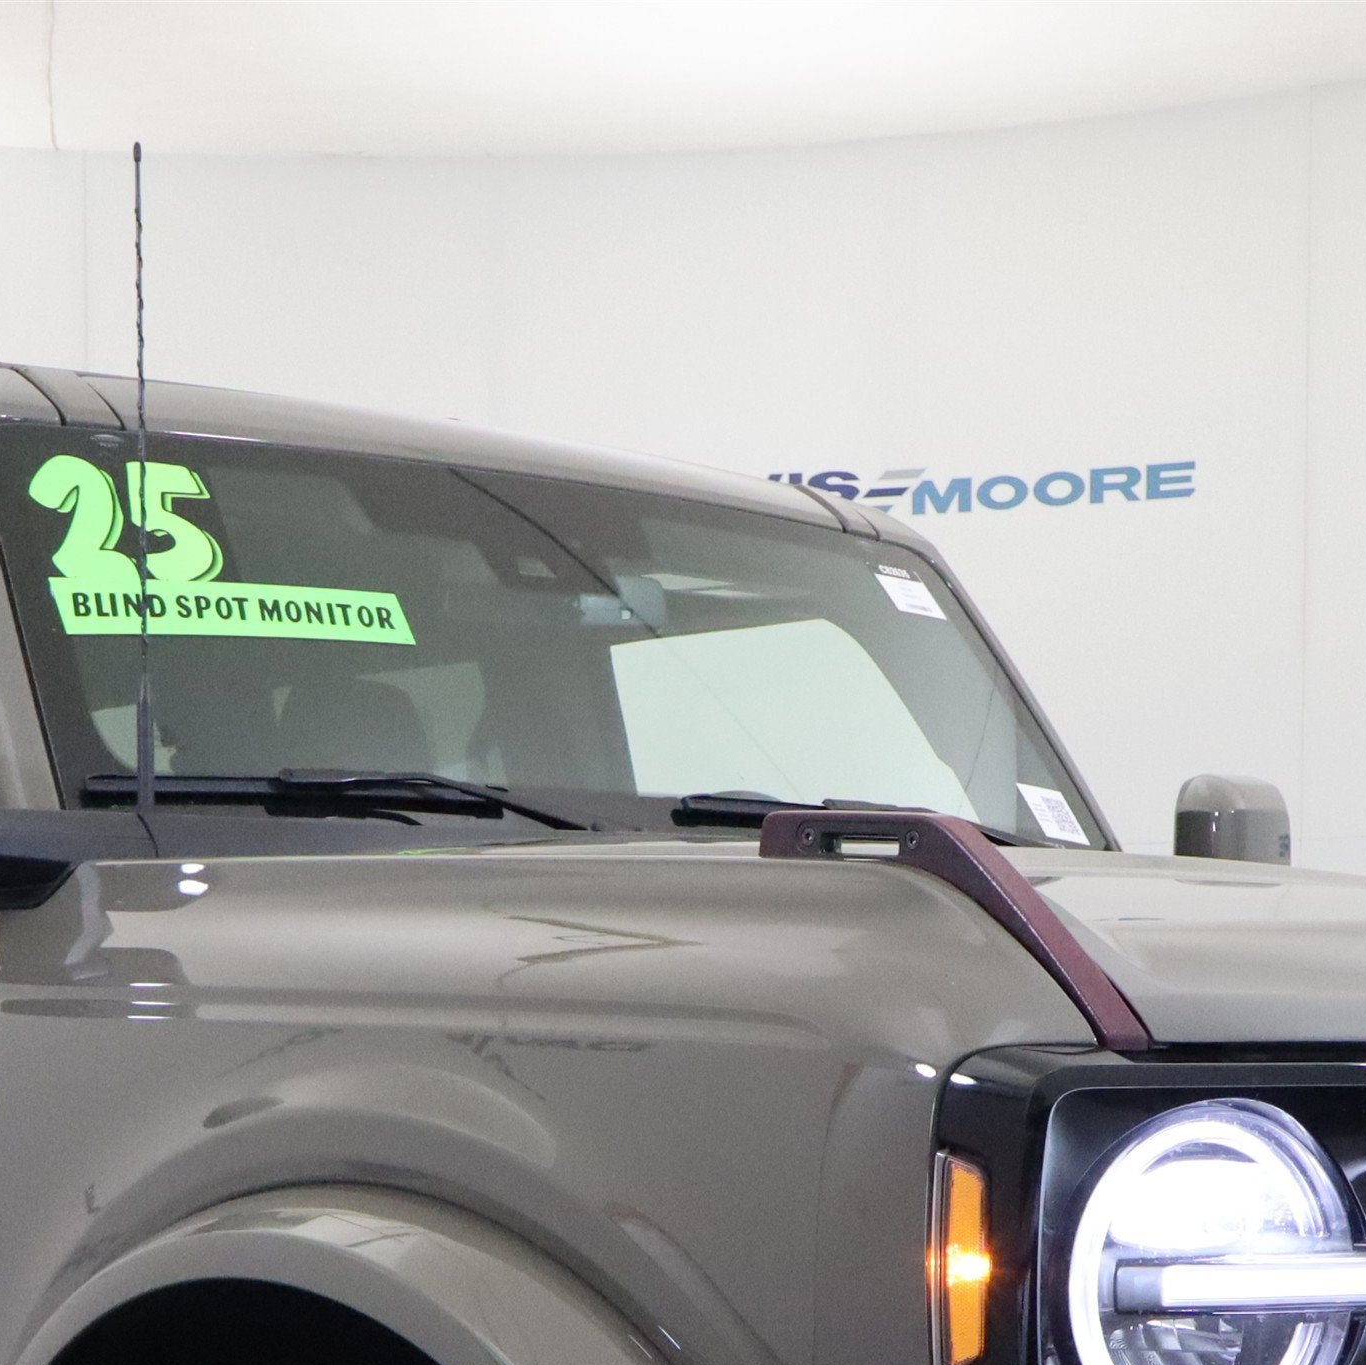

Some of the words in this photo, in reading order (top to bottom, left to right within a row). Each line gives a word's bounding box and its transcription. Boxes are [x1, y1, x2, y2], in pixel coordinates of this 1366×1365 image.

[911, 461, 1197, 516] MOORE
[28, 454, 224, 582] 25
[73, 592, 168, 619] BLIND
[176, 595, 249, 622] SPOT
[259, 598, 397, 631] MONITOR
